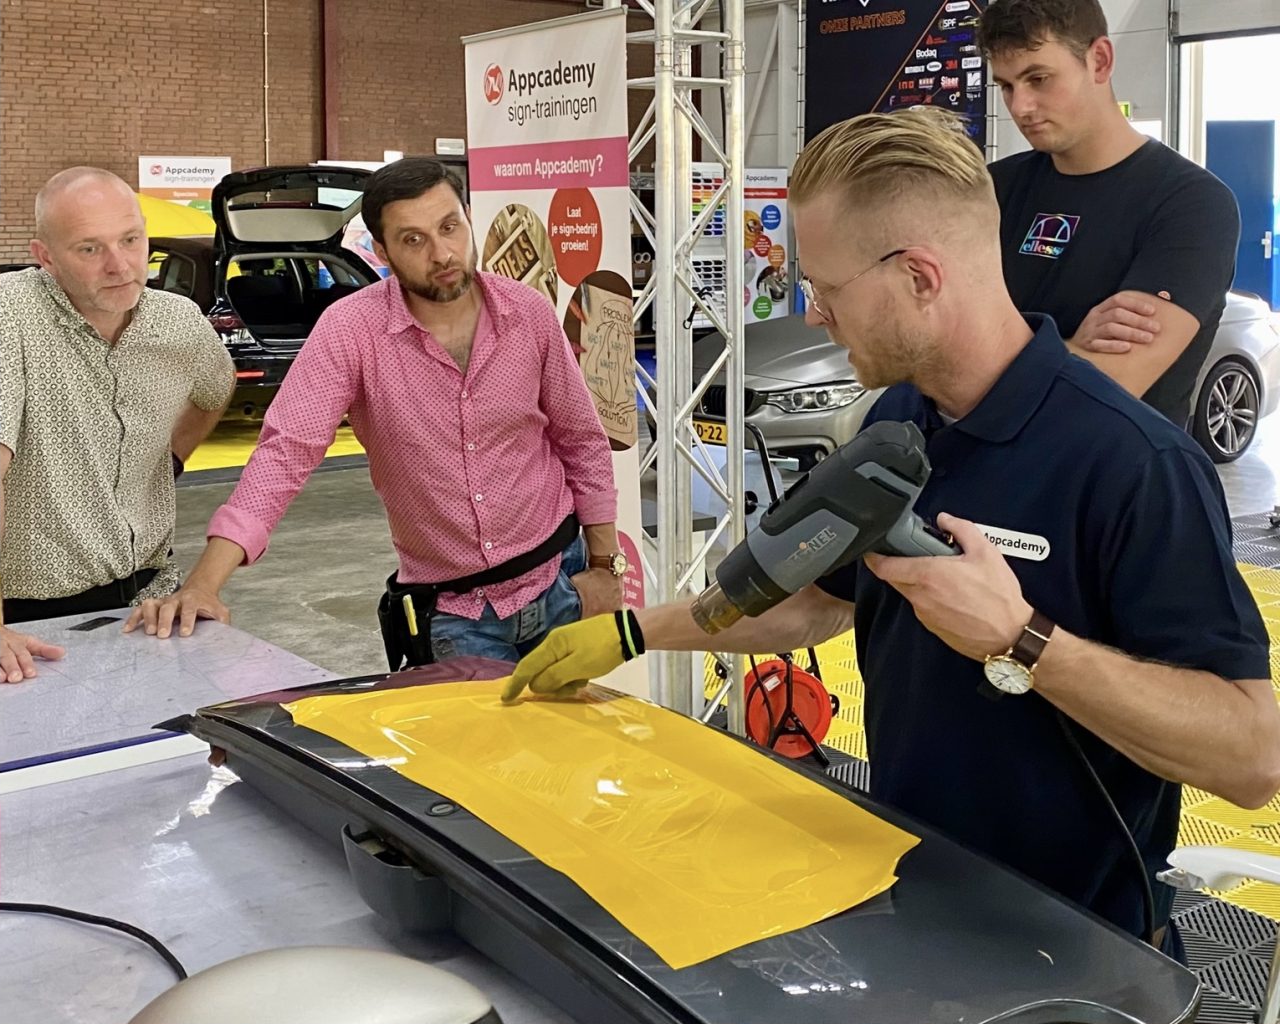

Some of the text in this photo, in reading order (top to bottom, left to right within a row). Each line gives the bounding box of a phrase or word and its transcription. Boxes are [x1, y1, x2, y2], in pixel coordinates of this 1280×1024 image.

[850, 9, 906, 31] PARTNERS
[508, 60, 596, 97] Appcademy
[508, 94, 597, 127] sign-trainingen
[165, 166, 215, 175] Appcademy
[494, 154, 604, 180] waarom Appcademy?
[566, 206, 582, 218] Laat
[551, 222, 598, 238] je sign-bedrijf
[561, 240, 589, 254] groeien!
[598, 406, 629, 427] SOLUTION
[693, 423, 723, 441] D-22
